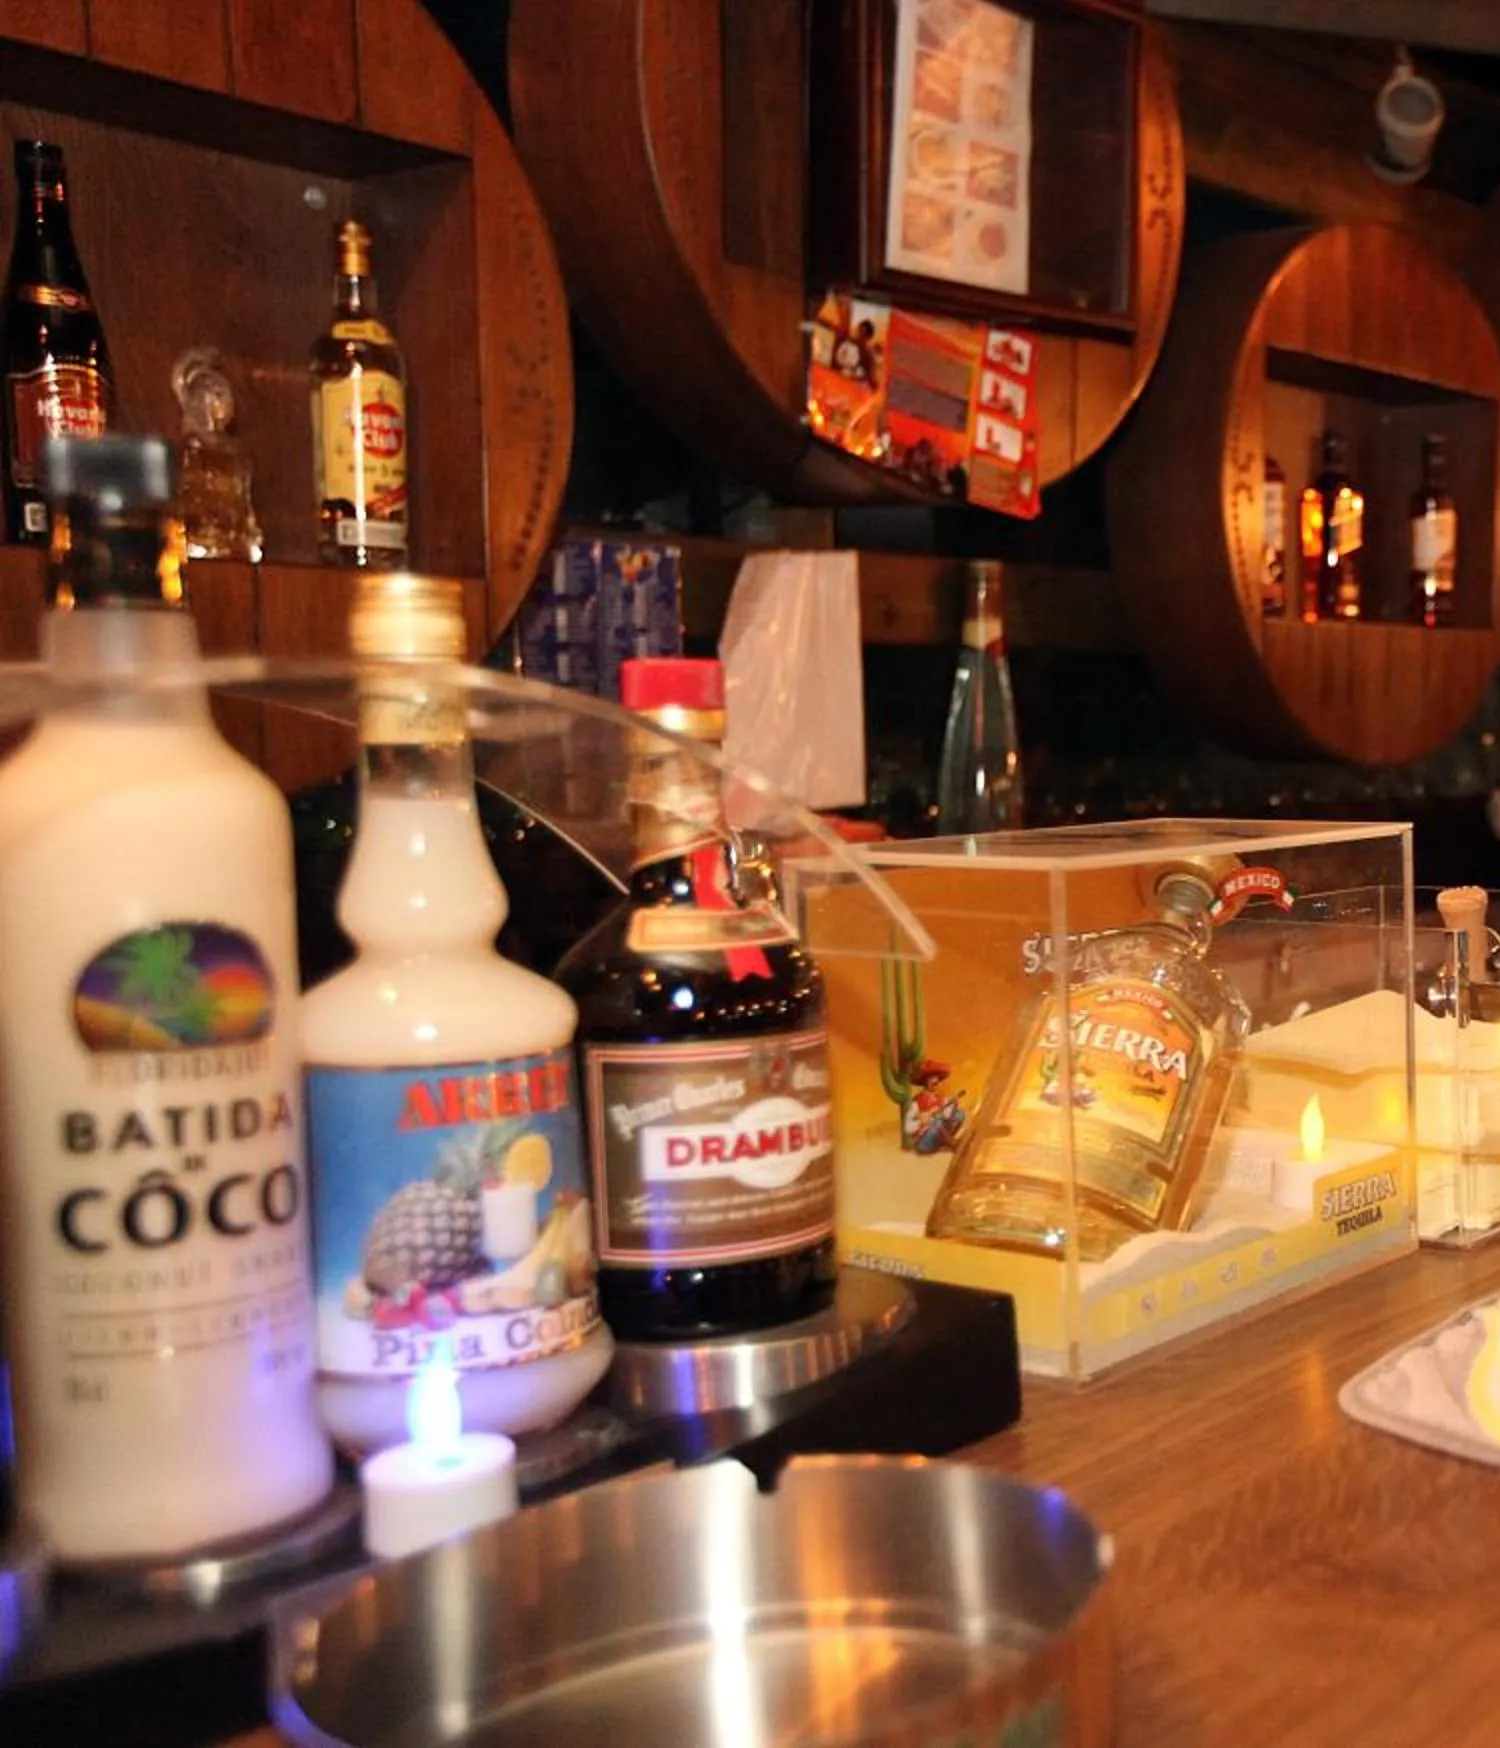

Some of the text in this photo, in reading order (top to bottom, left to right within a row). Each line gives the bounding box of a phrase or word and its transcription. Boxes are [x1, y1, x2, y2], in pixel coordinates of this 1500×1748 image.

[1224, 873, 1281, 893] MEXICO
[1038, 1009, 1188, 1081] SIERRA
[62, 1094, 294, 1154] BATIDA
[58, 1164, 299, 1255] CÔCO
[1321, 1171, 1397, 1222] SIERRA
[1336, 1204, 1384, 1237] TEQUILA
